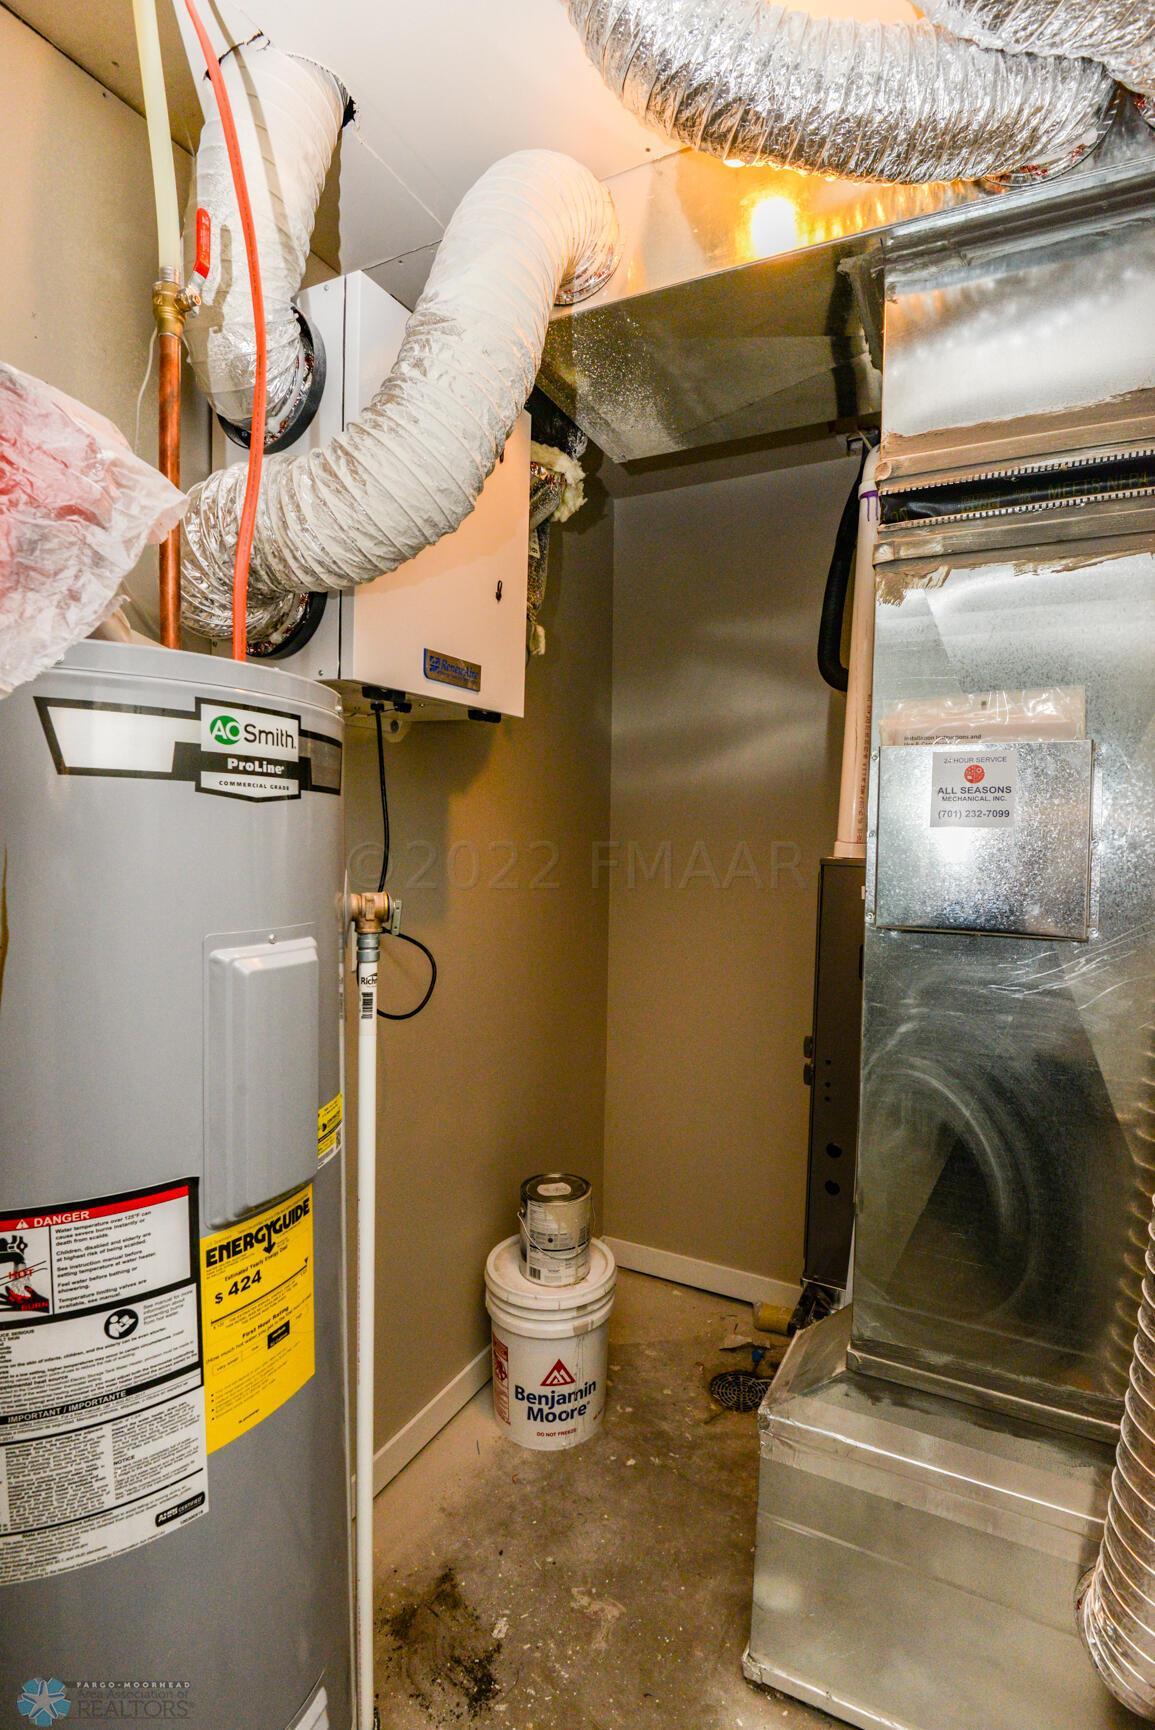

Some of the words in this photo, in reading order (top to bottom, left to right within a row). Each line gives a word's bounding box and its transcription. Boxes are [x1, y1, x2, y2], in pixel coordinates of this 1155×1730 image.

[243, 723, 295, 750] Smith
[227, 757, 282, 775] ProLine
[218, 780, 267, 789] COMMERCIAL
[270, 783, 290, 791] GRADE
[938, 787, 957, 795] ALL
[960, 786, 1012, 794] SEASONS
[938, 809, 962, 819] (701)
[965, 809, 1010, 818] 232-7099
[33, 1211, 90, 1227] DANGER
[114, 1220, 138, 1229] instantly
[74, 1221, 109, 1231] temperature
[79, 1263, 114, 1274] temperature
[228, 1269, 262, 1296] 424
[514, 1380, 597, 1409] Benjamin
[7, 1407, 61, 1424] IMPORTANT
[68, 1390, 127, 1412] IMPORTANTE
[527, 1404, 587, 1423] Moore
[558, 1428, 577, 1437] FREEZE
